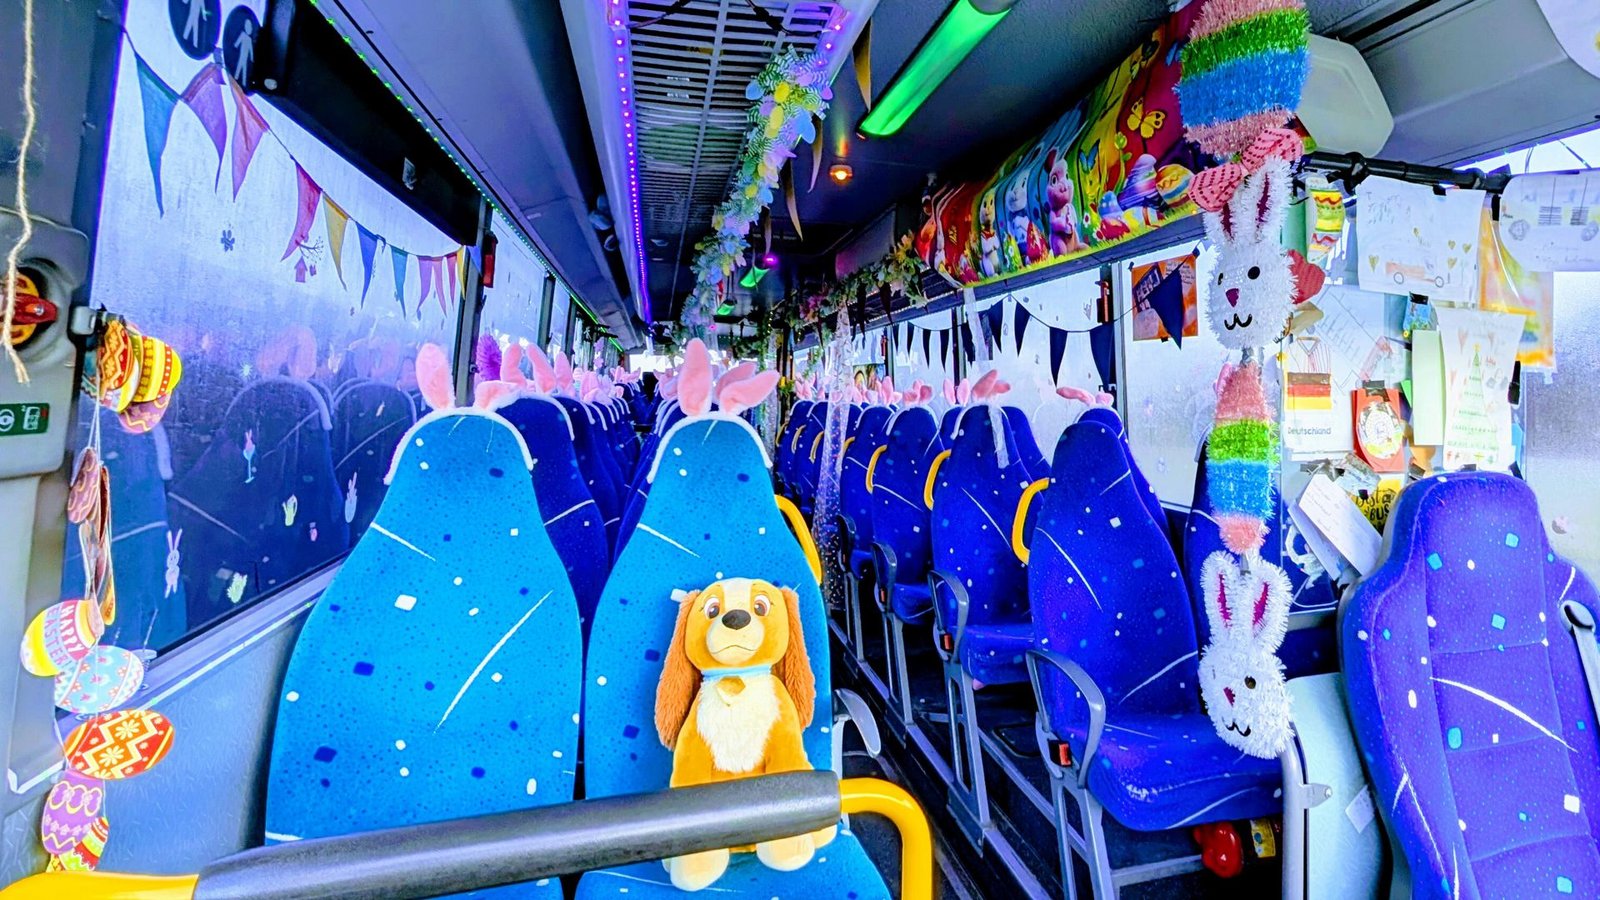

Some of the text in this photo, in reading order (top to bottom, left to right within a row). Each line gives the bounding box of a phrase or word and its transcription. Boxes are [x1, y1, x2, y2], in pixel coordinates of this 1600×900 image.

[1288, 427, 1332, 435] Deutschland
[1369, 503, 1390, 521] BUS
[59, 605, 84, 653] HAPPY
